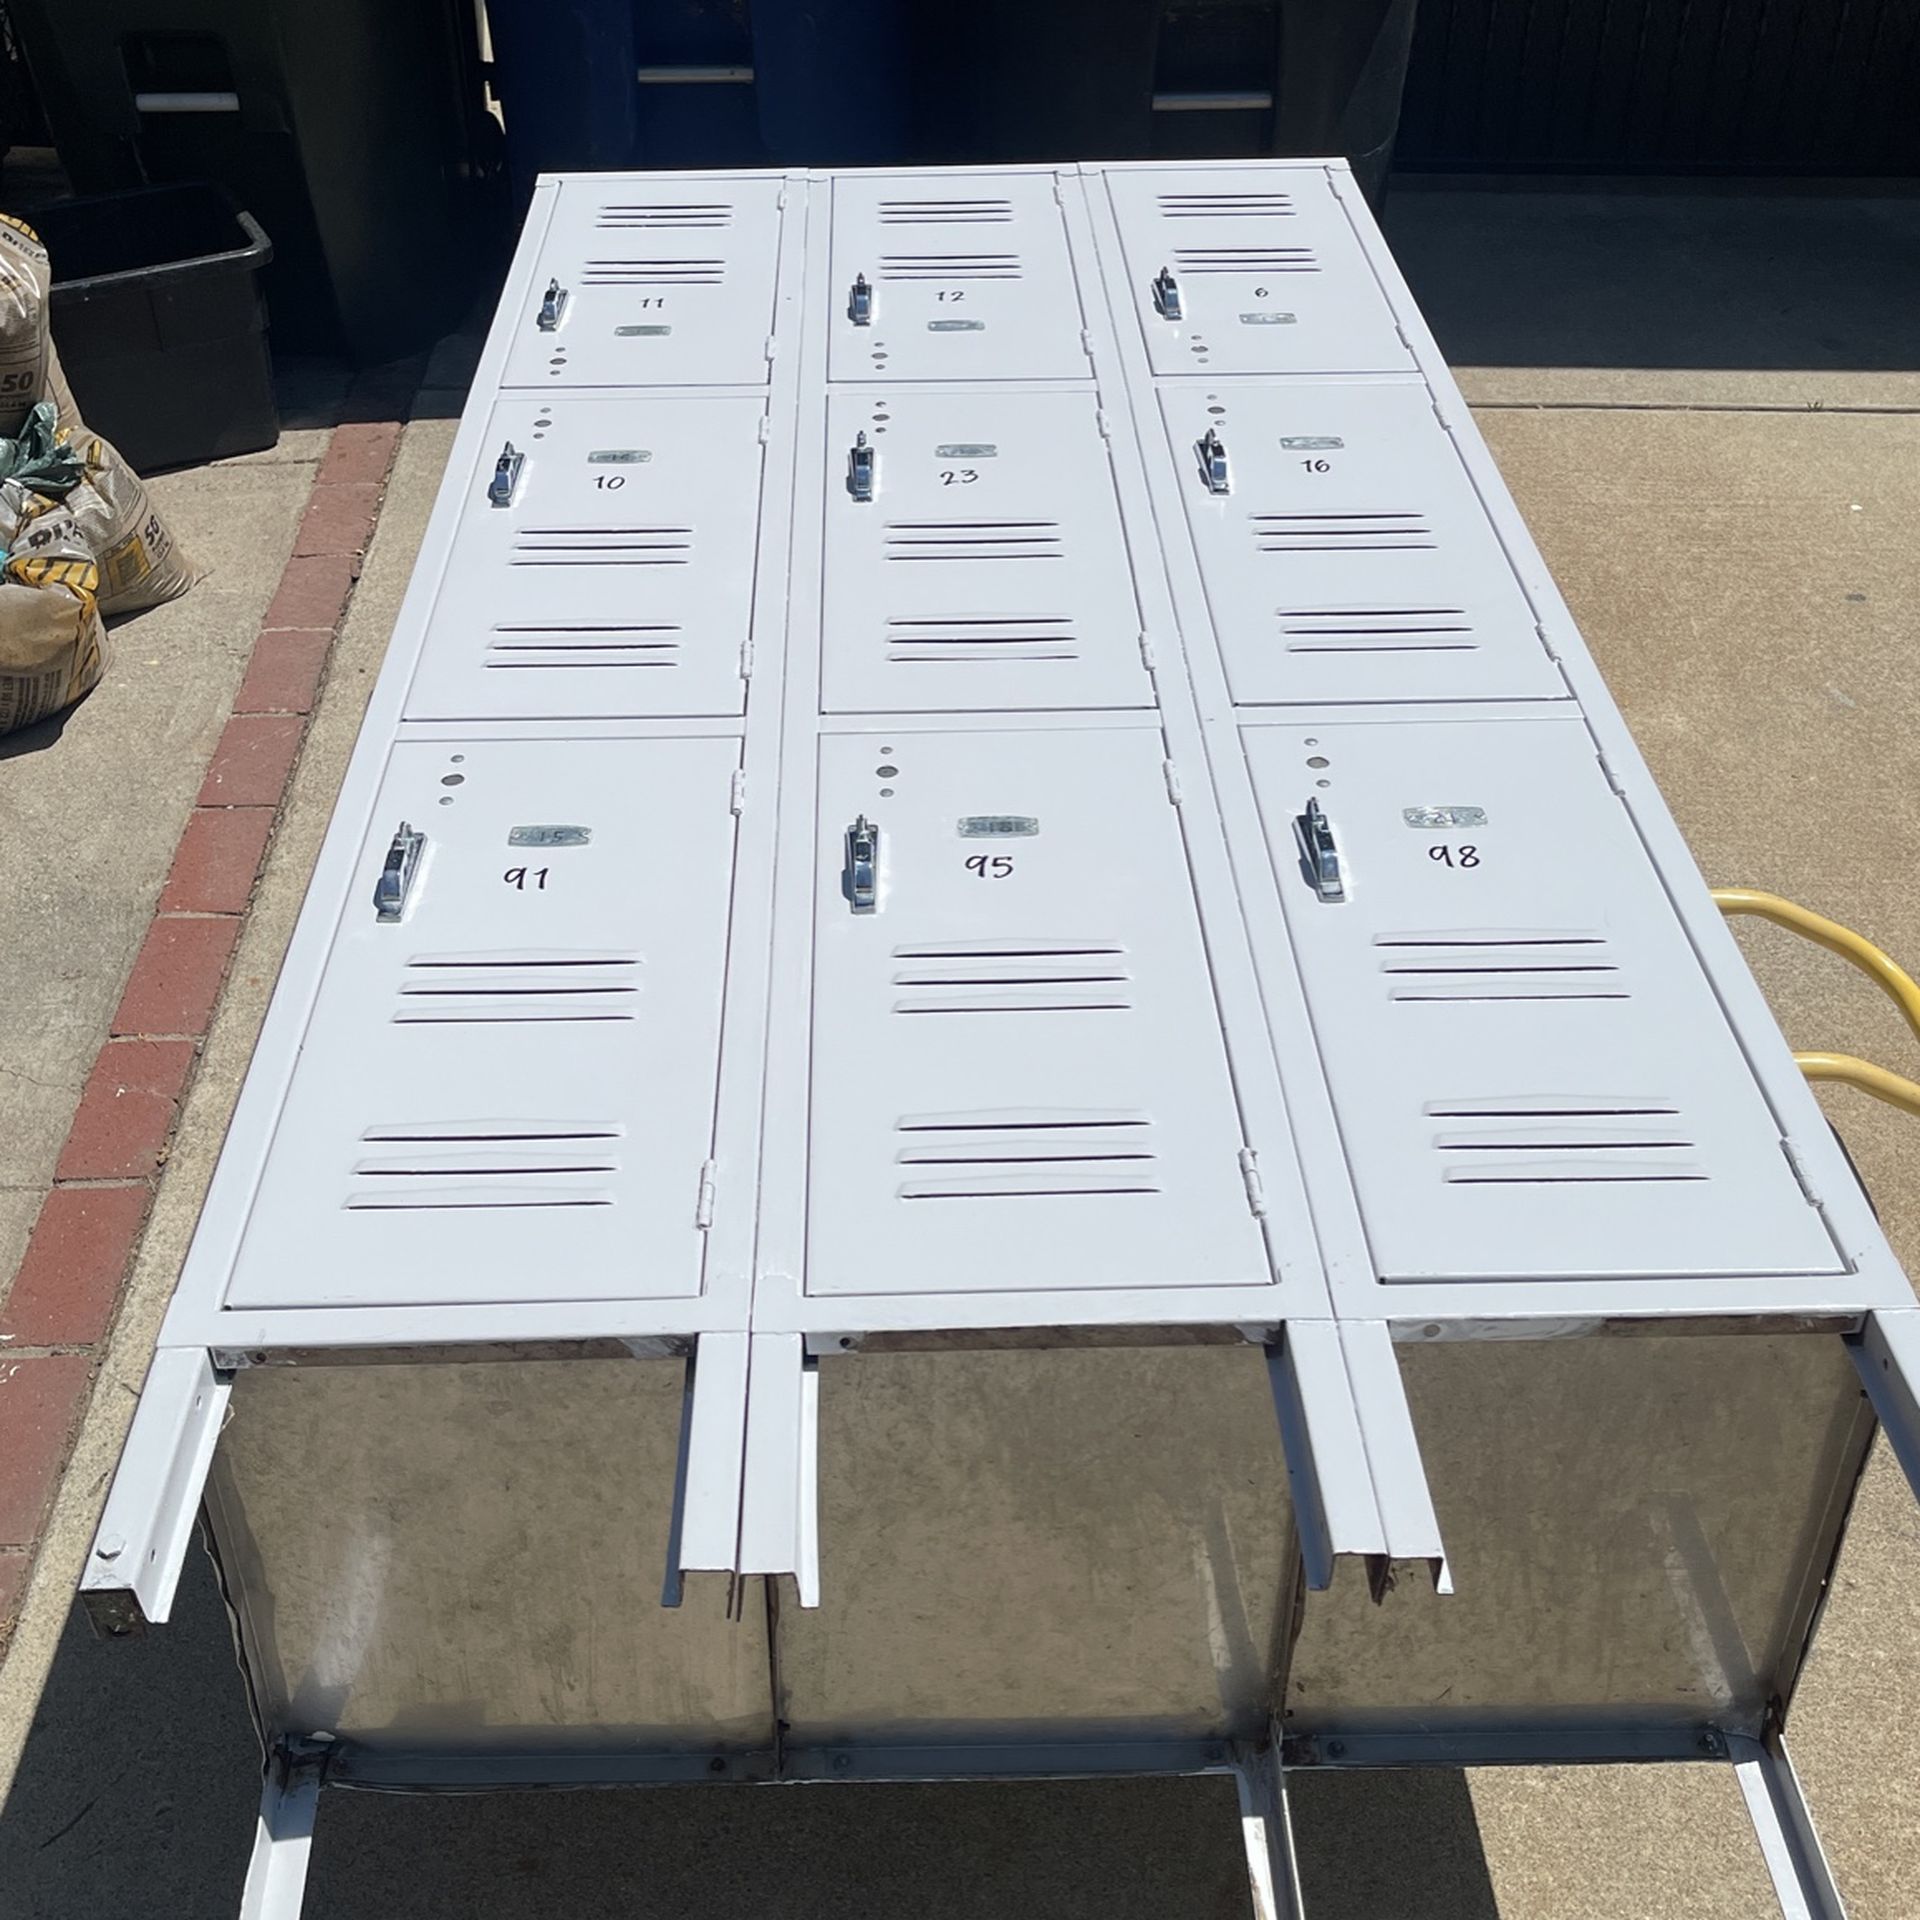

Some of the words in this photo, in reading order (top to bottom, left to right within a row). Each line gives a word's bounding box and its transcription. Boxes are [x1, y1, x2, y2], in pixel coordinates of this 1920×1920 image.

[937, 290, 965, 303] 12
[1254, 287, 1269, 298] 6
[640, 297, 664, 309] 11
[1, 371, 34, 392] 50
[1299, 459, 1331, 473] 16
[592, 475, 626, 490] 10
[939, 468, 980, 486] 23
[144, 514, 160, 546] 50
[539, 830, 566, 844] 15
[1428, 844, 1481, 869] 98
[964, 854, 1014, 879] 95
[503, 866, 550, 891] 91
